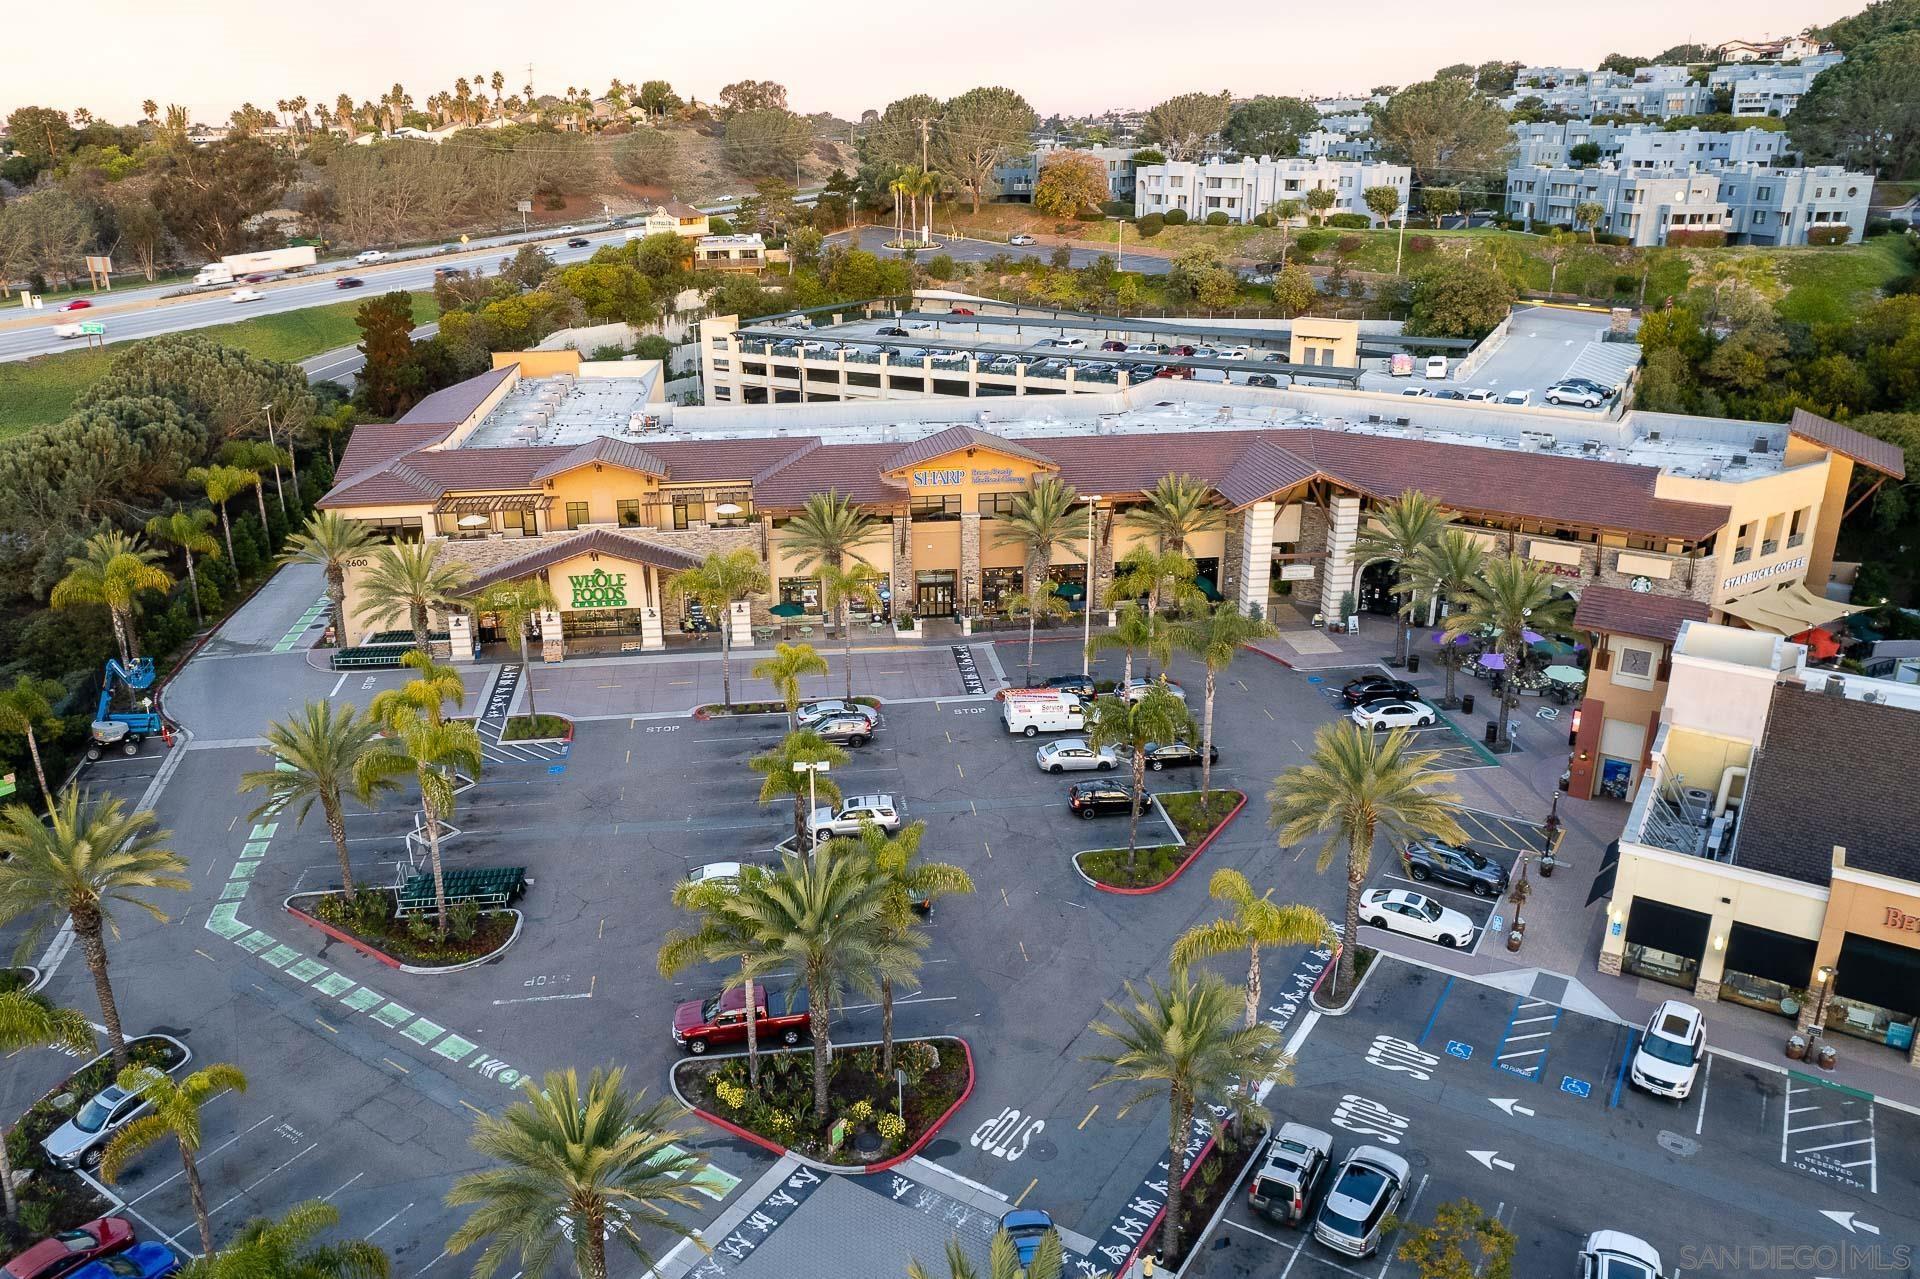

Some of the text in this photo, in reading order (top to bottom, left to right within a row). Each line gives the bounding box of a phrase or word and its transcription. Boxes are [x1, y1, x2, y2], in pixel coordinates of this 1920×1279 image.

[914, 470, 965, 487] SHARP
[346, 559, 368, 567] 2600
[1723, 556, 1807, 590] STARBUCKS COFFEE
[568, 569, 627, 588] WHOLE
[572, 587, 625, 601] FOODS
[953, 707, 986, 715] STOP
[1883, 906, 1920, 933] BE
[1364, 1035, 1441, 1081] STOP
[1509, 1065, 1532, 1077] PARKING
[1331, 1094, 1411, 1145] STOP
[970, 1106, 1046, 1162] STOP
[1793, 1161, 1807, 1170] 10
[1846, 1178, 1865, 1189] PM
[1804, 1156, 1853, 1177] RESERVED
